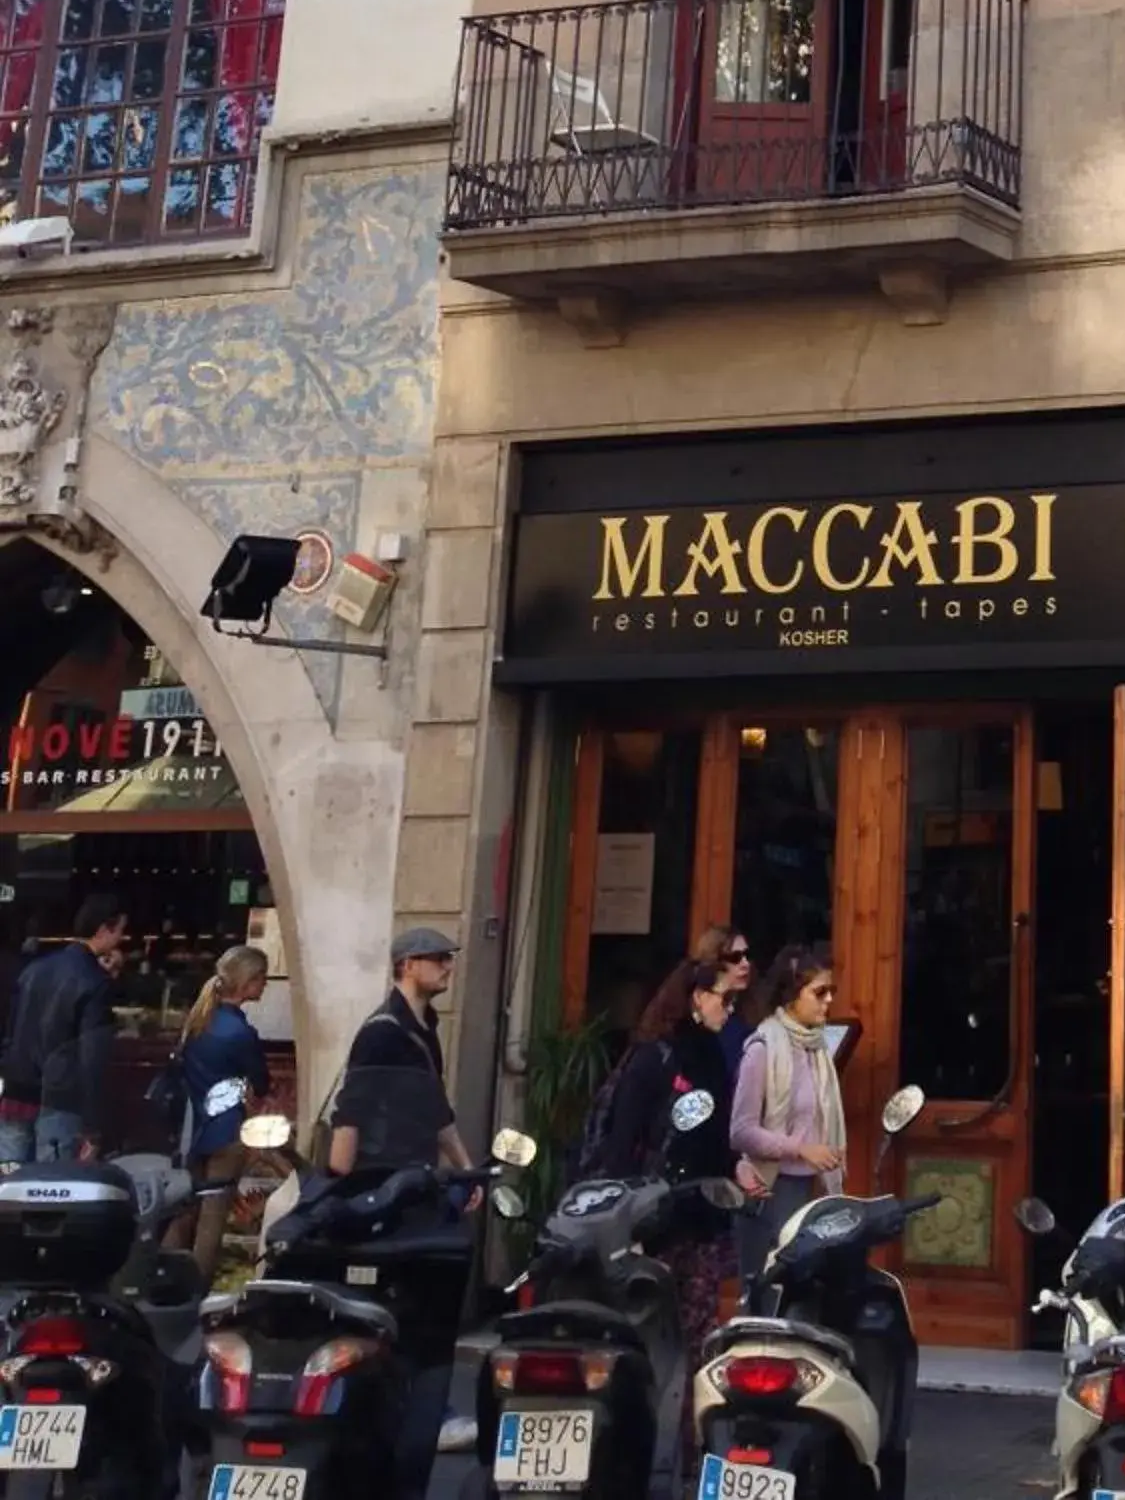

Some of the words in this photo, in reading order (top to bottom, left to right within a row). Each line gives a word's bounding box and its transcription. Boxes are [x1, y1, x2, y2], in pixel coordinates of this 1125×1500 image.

[592, 495, 1058, 599] MACCABI
[592, 601, 849, 631] restaurant
[921, 595, 1058, 619] tapes
[779, 629, 848, 647] KOSHER
[23, 769, 64, 784] BAR
[76, 766, 222, 783] RESTAURANT
[18, 1410, 77, 1436] 0744
[521, 1414, 588, 1444] 8976
[12, 1438, 55, 1463] HML
[517, 1447, 568, 1477] FHJ
[232, 1469, 300, 1500] 4748
[722, 1467, 787, 1500] 9923
